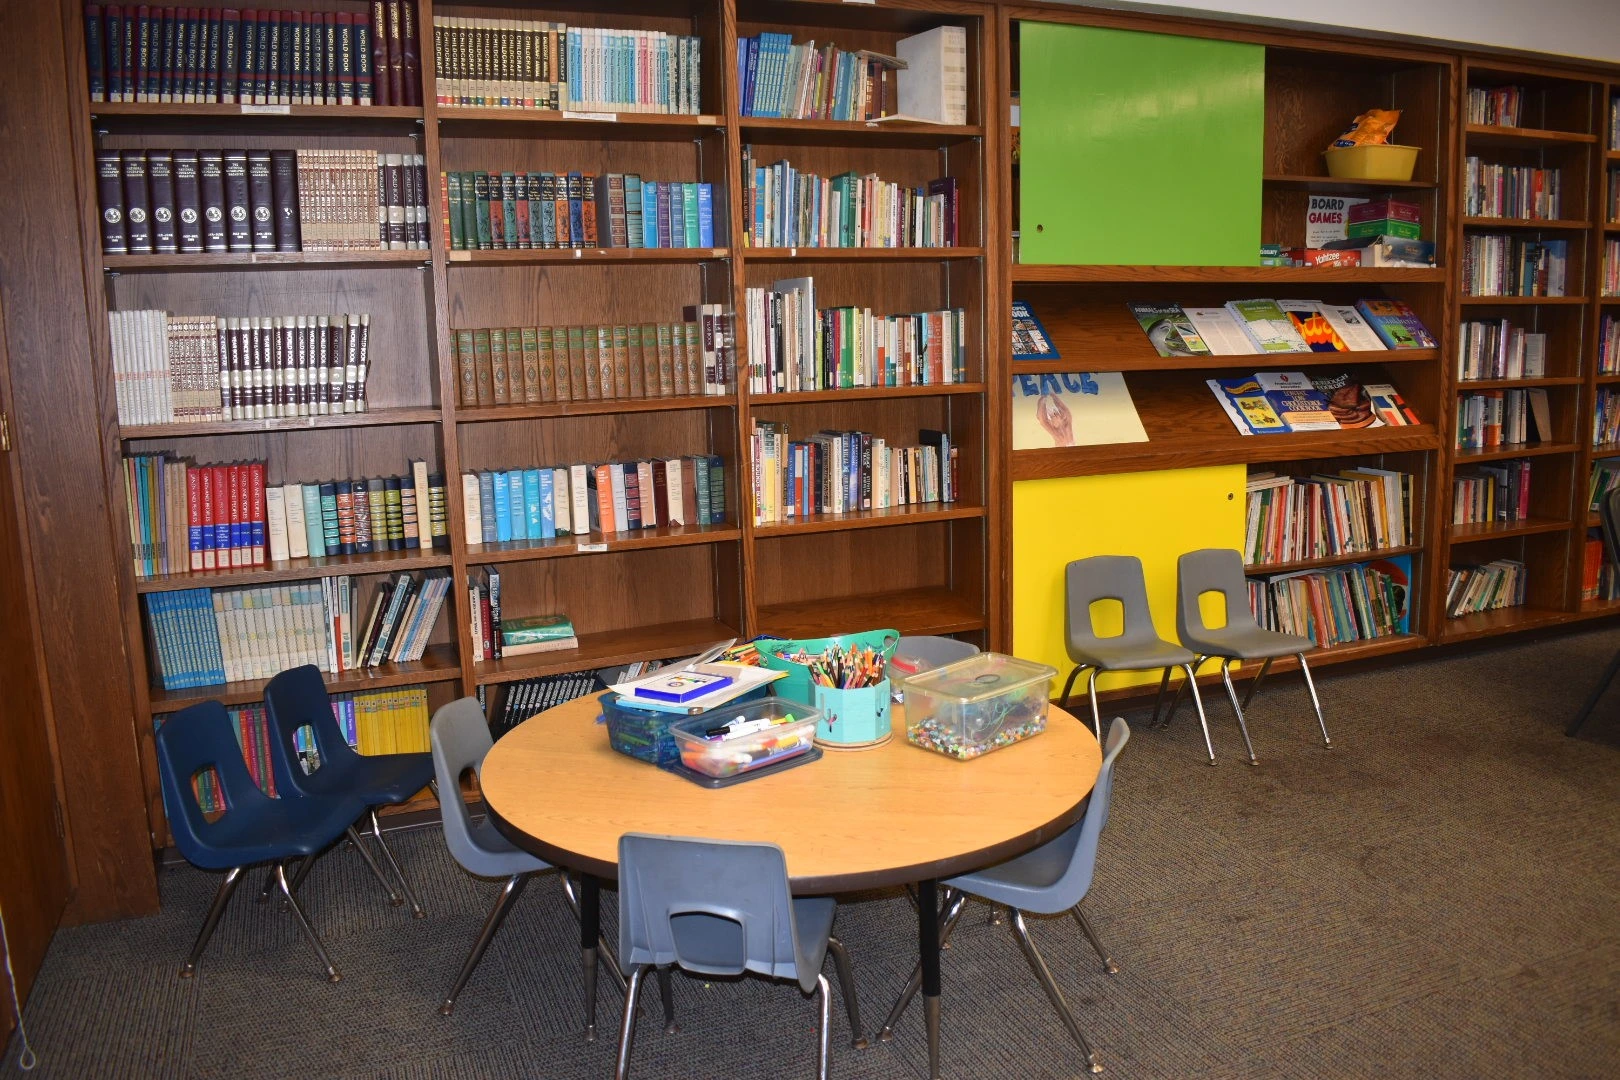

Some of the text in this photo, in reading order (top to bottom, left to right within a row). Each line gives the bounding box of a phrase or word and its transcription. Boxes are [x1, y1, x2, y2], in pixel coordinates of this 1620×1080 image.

[1311, 198, 1344, 210] BOARD
[1309, 213, 1342, 224] GAMES
[1315, 252, 1340, 264] Yahtzee
